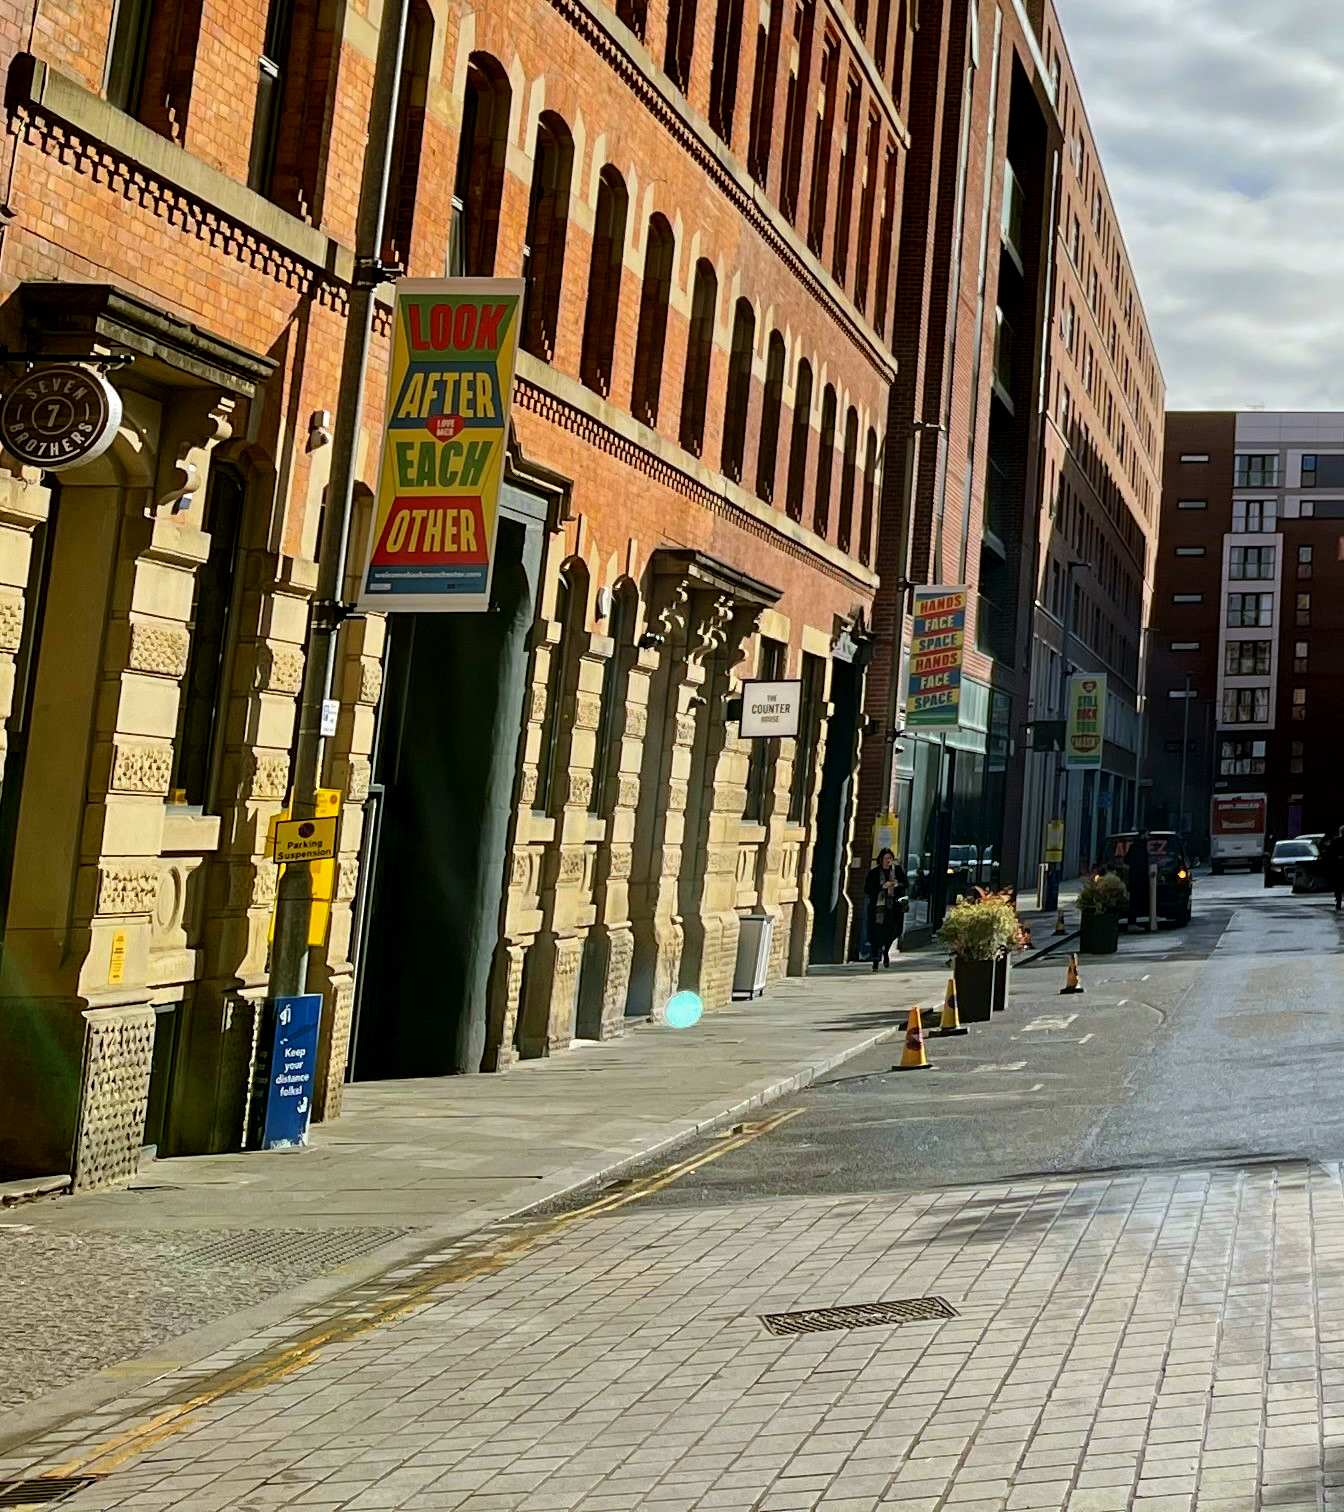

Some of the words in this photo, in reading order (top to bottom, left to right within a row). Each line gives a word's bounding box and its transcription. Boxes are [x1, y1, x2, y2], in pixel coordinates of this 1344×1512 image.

[408, 303, 509, 351] LOOK
[25, 377, 88, 400] SEVEN
[397, 371, 496, 419] AFTER
[47, 404, 60, 428] 7
[396, 440, 494, 488] EACH
[386, 508, 478, 554] OTHER
[920, 594, 962, 614] HANDS
[925, 614, 955, 632] FACE
[919, 633, 958, 651] SPACE
[915, 652, 958, 672] HANDS
[921, 671, 951, 689] FACE
[751, 703, 791, 715] COUNTER
[914, 691, 953, 709] SPACE
[286, 839, 323, 850] Parking
[277, 848, 332, 860] Suspension
[284, 1047, 307, 1059] Keep
[283, 1060, 304, 1073] your
[275, 1073, 310, 1085] distance
[280, 1086, 303, 1097] folks!
